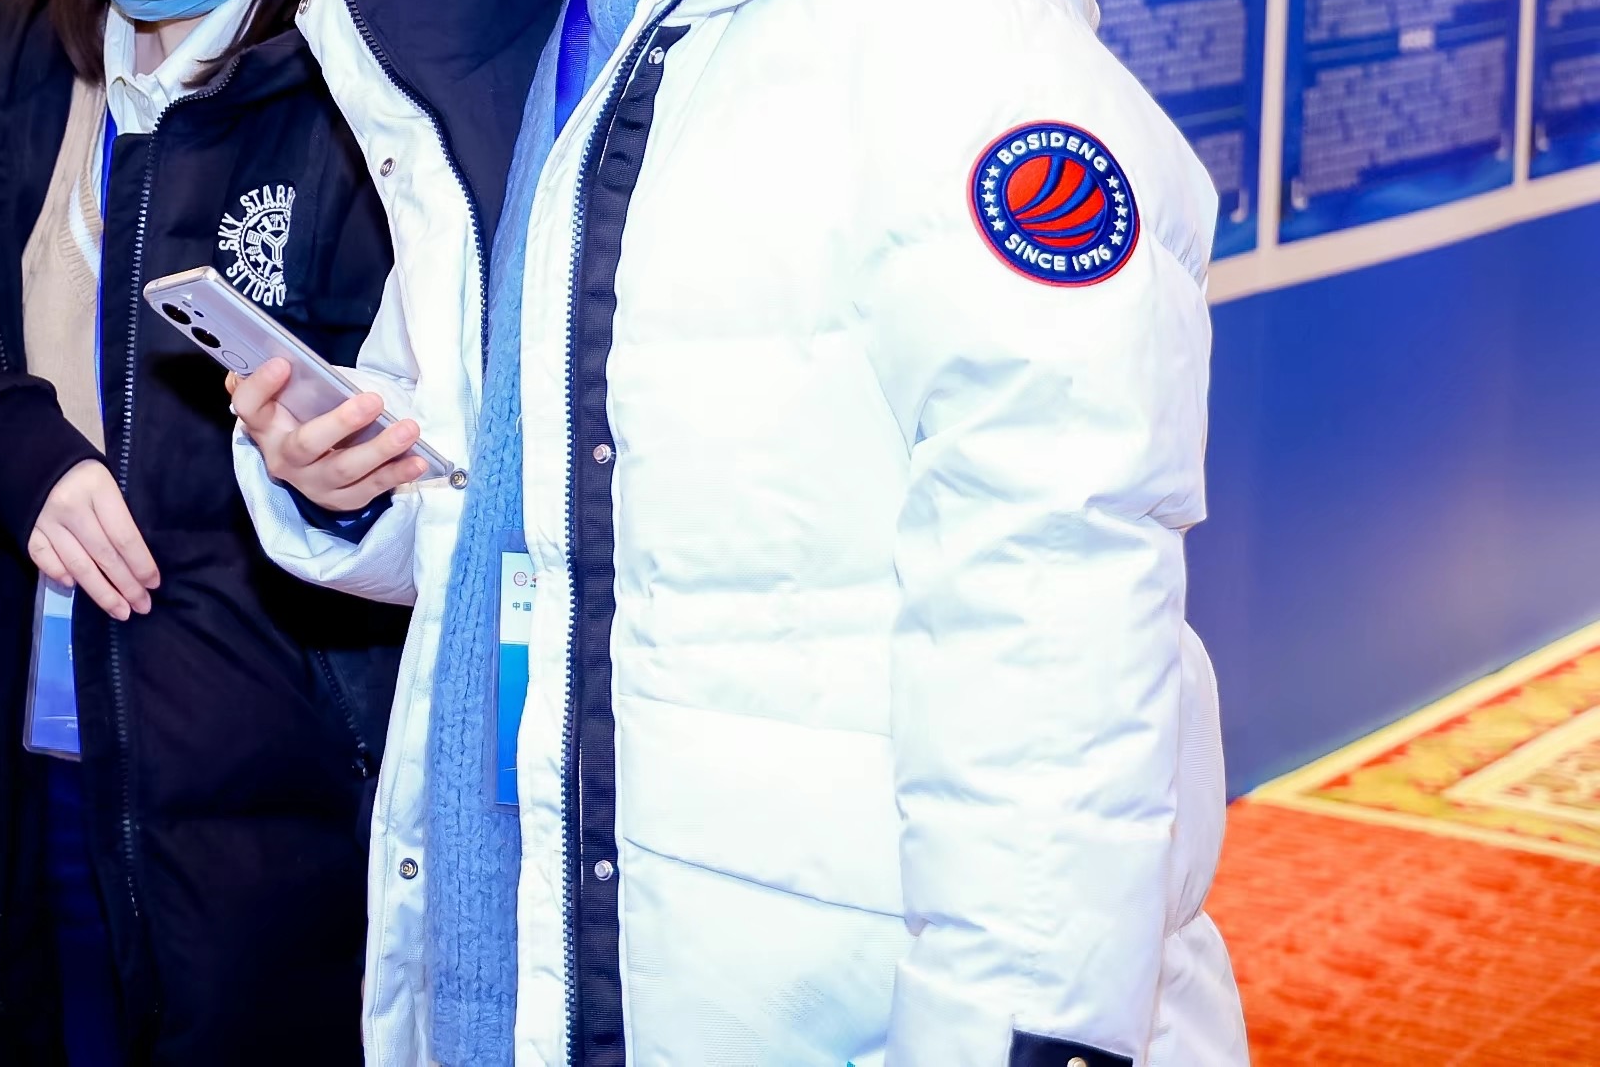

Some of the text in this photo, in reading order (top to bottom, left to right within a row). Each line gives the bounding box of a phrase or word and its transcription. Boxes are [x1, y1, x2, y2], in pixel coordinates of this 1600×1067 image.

[997, 132, 1108, 173] BOSIDENG
[1004, 233, 1111, 272] SINCE 1976
